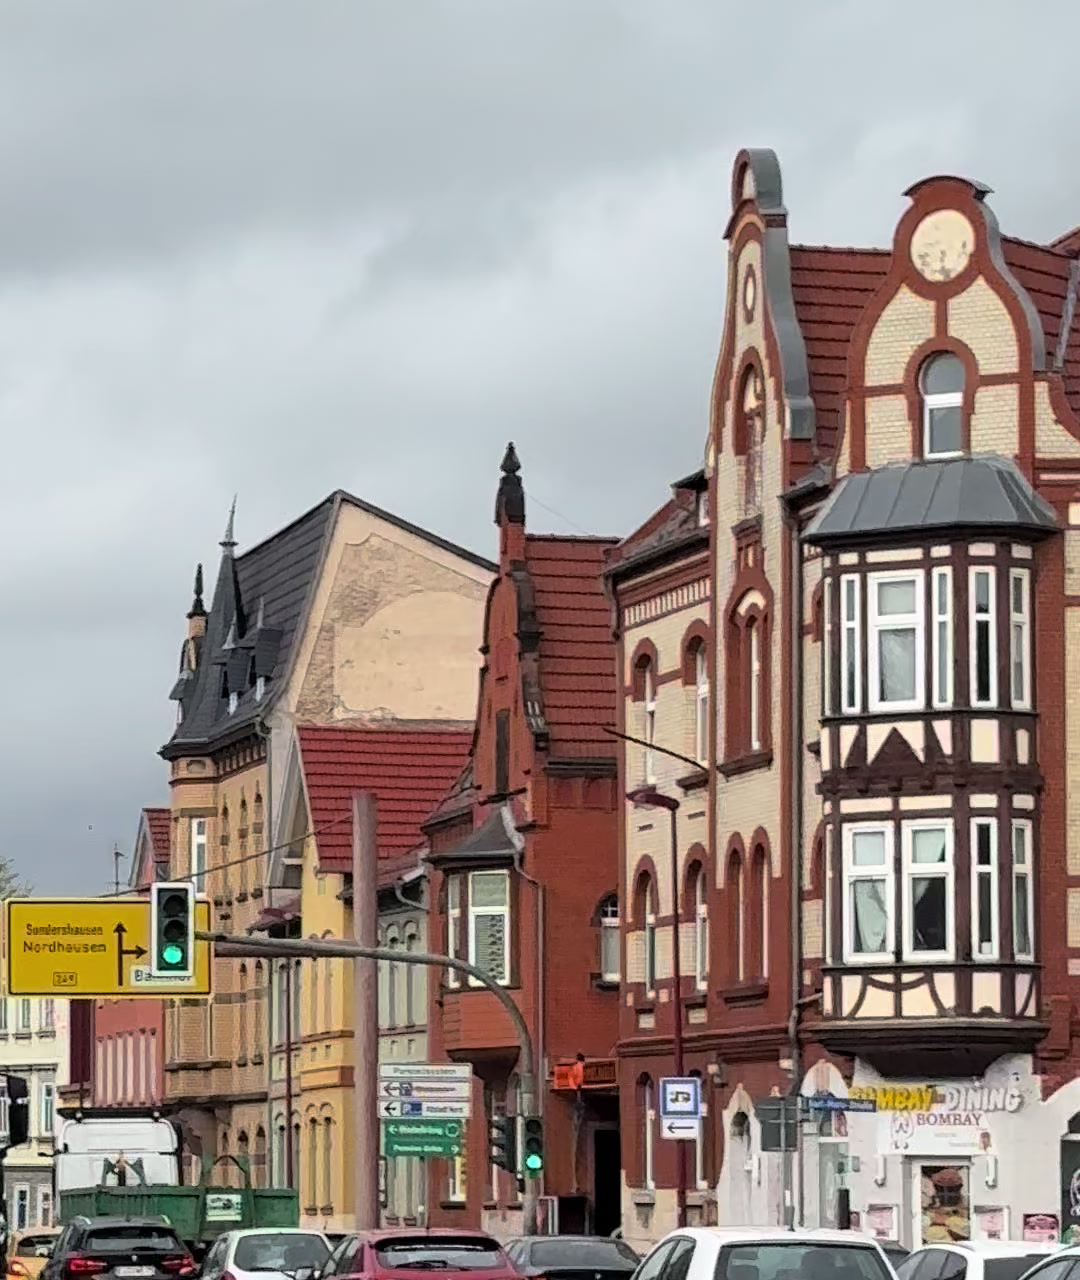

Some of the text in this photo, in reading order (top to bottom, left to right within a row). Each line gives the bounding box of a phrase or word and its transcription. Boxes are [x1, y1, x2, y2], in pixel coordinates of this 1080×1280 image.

[26, 923, 104, 936] Sondershausen
[23, 941, 107, 953] Nordhausen
[944, 1087, 1023, 1113] DINING
[916, 1111, 984, 1127] BOMBAY
